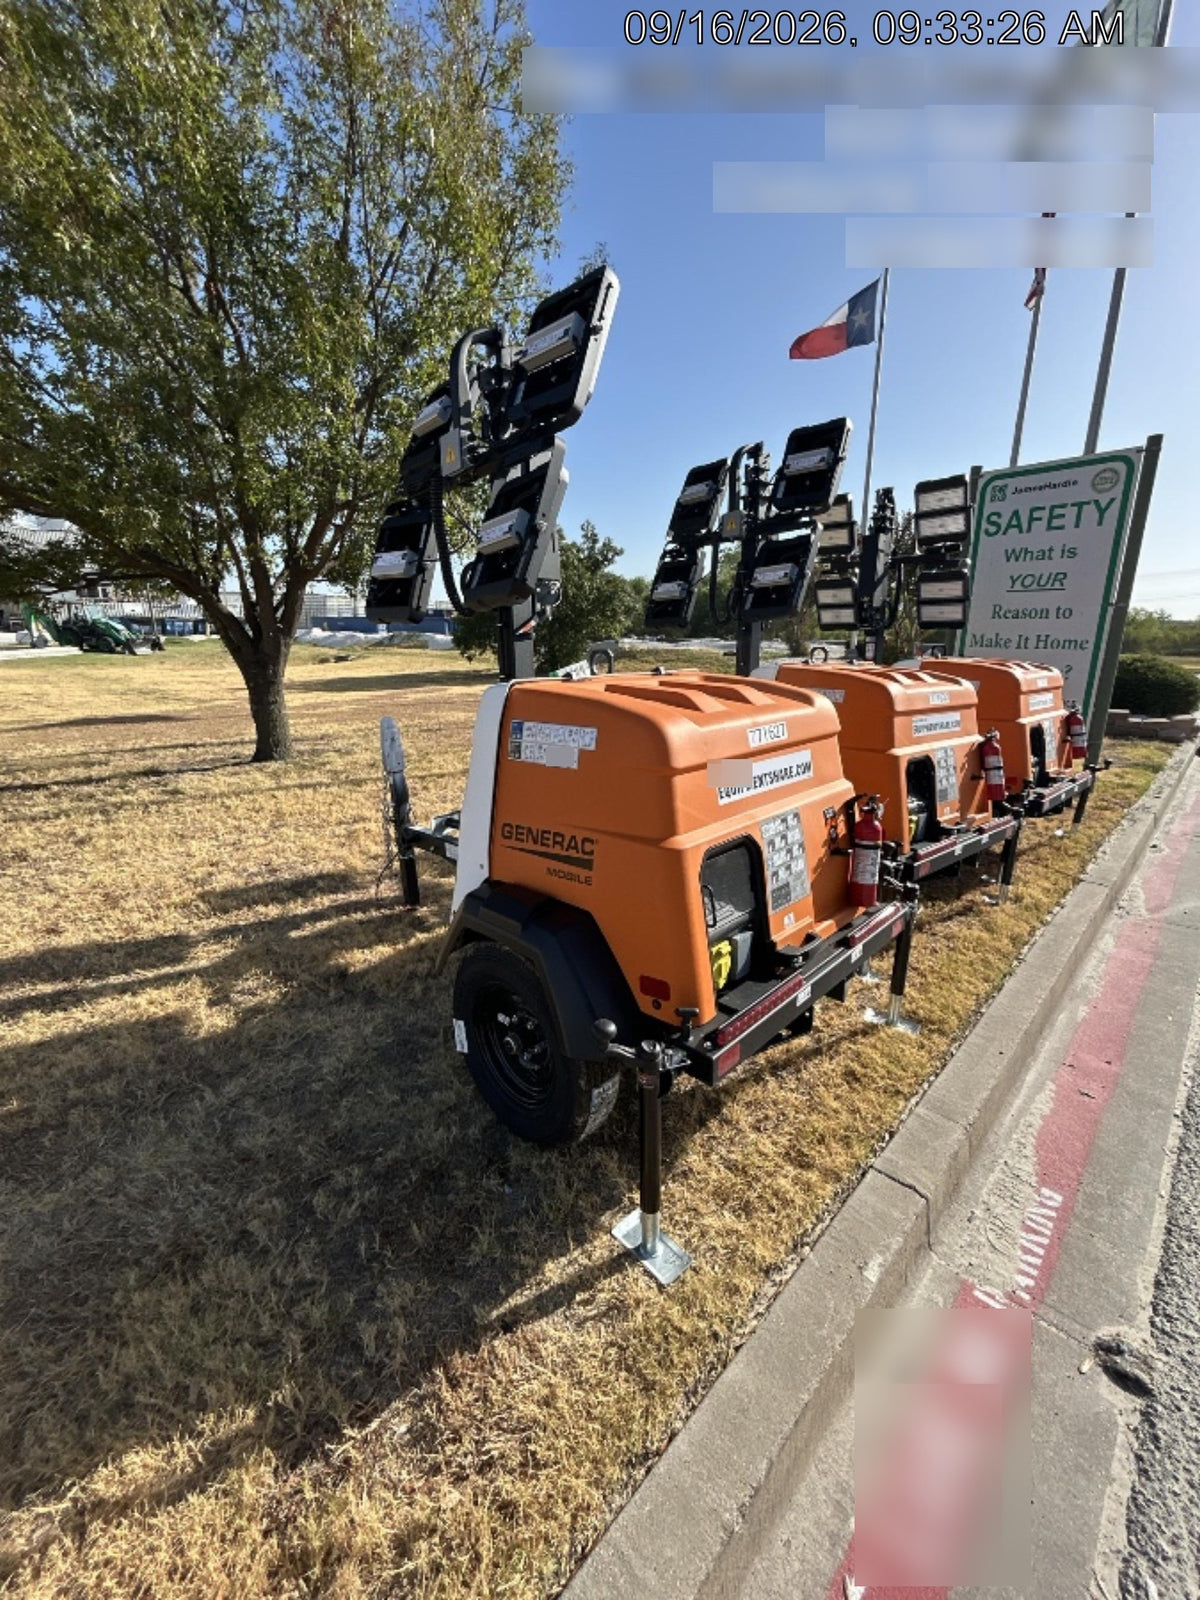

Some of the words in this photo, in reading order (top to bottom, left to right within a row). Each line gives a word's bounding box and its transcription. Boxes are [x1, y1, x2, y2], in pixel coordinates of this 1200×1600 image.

[983, 496, 1118, 538] SAFETY
[1004, 545, 1054, 563] What
[1060, 543, 1079, 560] is
[1008, 571, 1068, 590] YOUR
[991, 603, 1050, 620] Reason
[1055, 605, 1073, 620] to
[968, 632, 1012, 649] Make
[1014, 634, 1030, 650] It
[1033, 634, 1090, 651] Home
[501, 822, 595, 856] GENERAC
[545, 866, 593, 886] MOBILE
